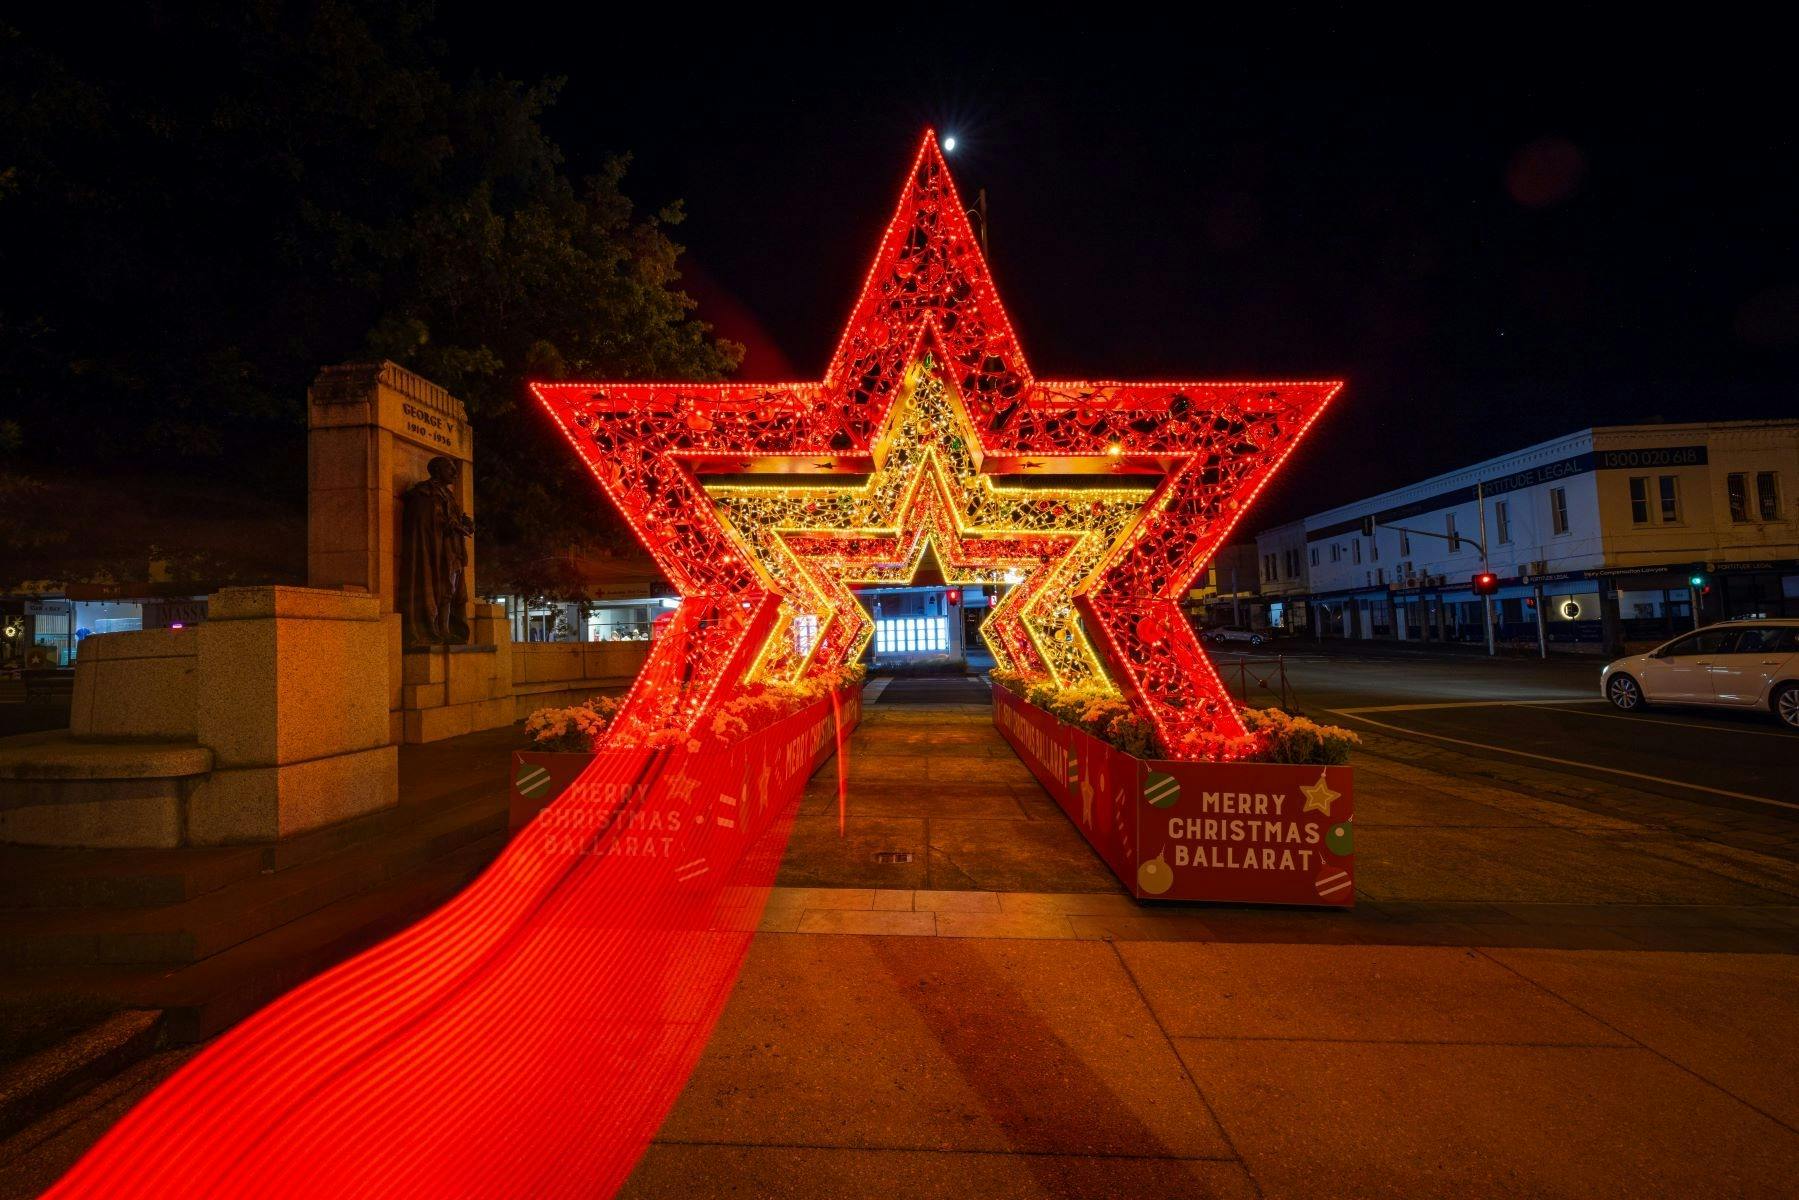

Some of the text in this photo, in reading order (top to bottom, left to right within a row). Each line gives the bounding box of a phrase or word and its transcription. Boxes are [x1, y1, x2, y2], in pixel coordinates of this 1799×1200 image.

[403, 403, 453, 433] GEORGE V
[407, 421, 426, 436] 1910
[1537, 459, 1582, 481] LEGAL
[1604, 448, 1697, 467] 1300 020 618
[570, 782, 650, 804] MERRY
[1202, 791, 1287, 816] MERRY
[540, 807, 682, 832] CHRISTMAS
[1168, 817, 1320, 845] CHRISTMAS
[544, 833, 674, 858] BALLARAT
[1175, 844, 1313, 872] BALLARAT
